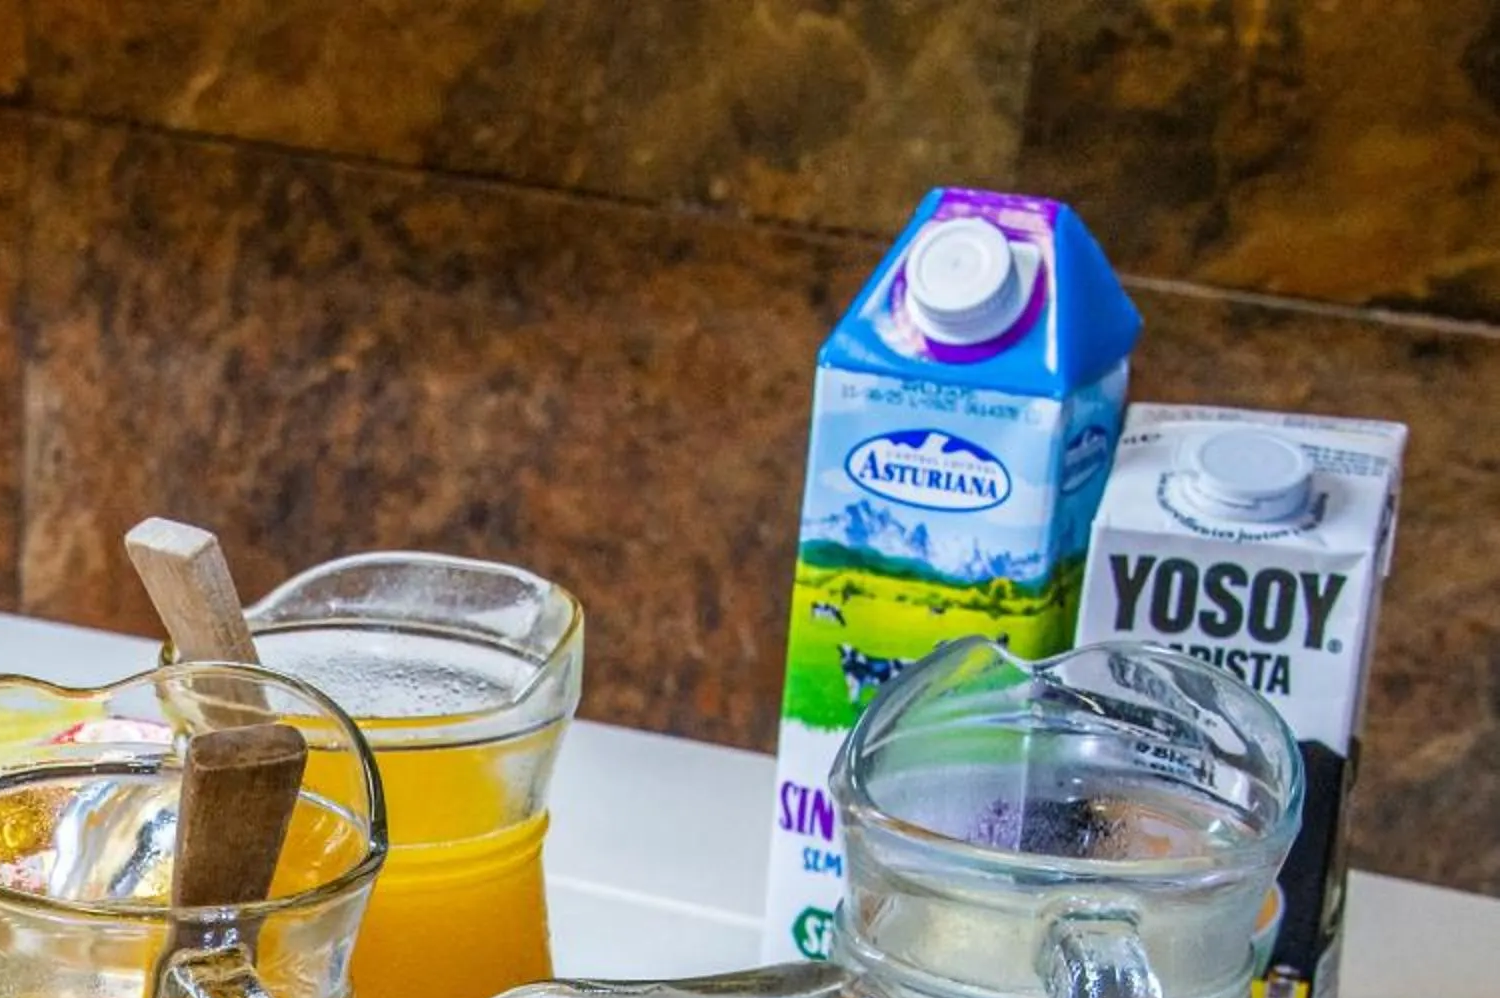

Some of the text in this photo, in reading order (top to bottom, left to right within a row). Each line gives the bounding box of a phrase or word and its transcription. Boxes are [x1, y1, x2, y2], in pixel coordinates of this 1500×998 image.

[859, 450, 998, 499] ASTURIANA
[1109, 554, 1347, 650] YOSOY
[1168, 642, 1291, 695] ISTA
[779, 780, 835, 842] SIN
